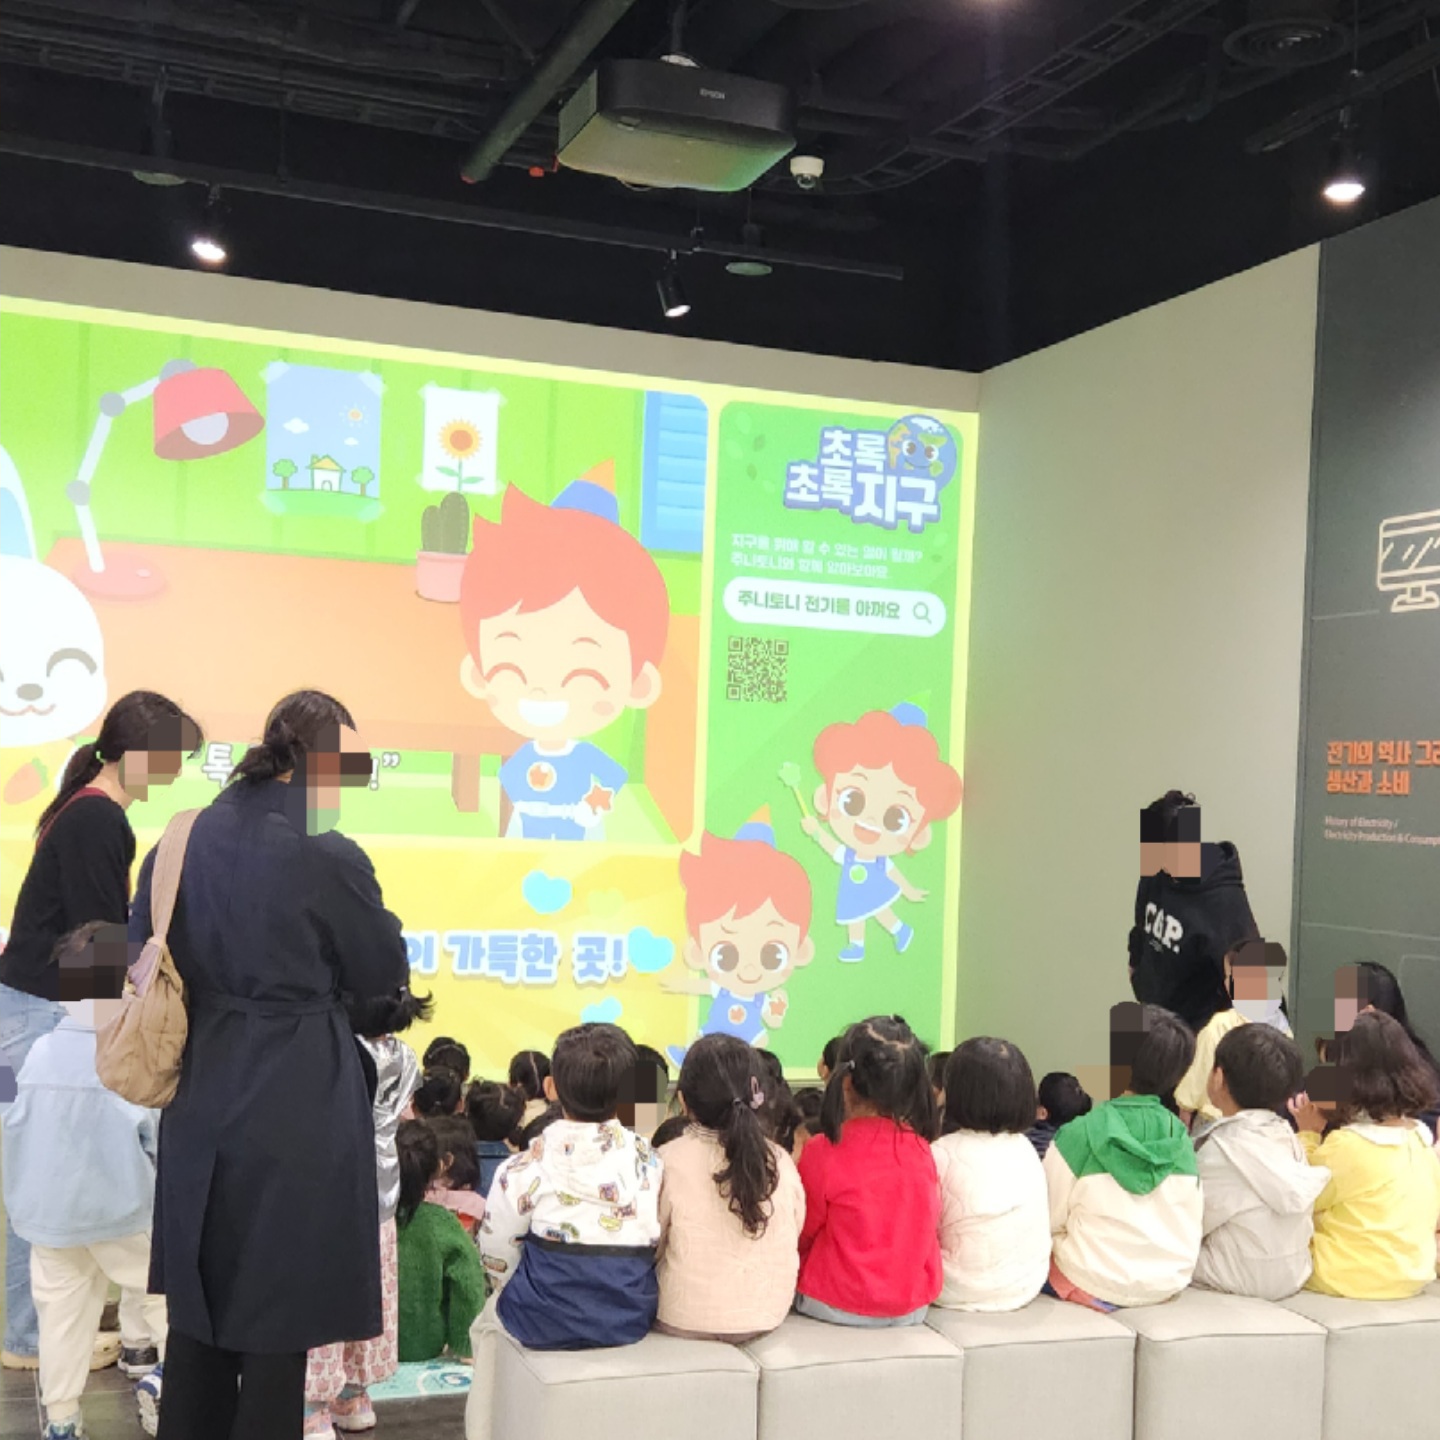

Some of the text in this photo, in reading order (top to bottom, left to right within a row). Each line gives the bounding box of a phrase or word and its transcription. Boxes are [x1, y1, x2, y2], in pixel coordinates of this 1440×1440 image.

[822, 429, 887, 472] 초록
[819, 541, 831, 556] 수
[737, 589, 901, 620] 주니토니 전기를 아껴요
[1326, 740, 1374, 766] 전기의
[1378, 740, 1412, 766] 역사
[1326, 768, 1411, 796] 생산과 소비
[1324, 829, 1358, 842] Electricity
[1359, 831, 1398, 843] Production
[1325, 815, 1349, 828] History
[1358, 817, 1394, 830] Electricity
[447, 933, 558, 978] 가득한
[576, 936, 624, 978] 곳!
